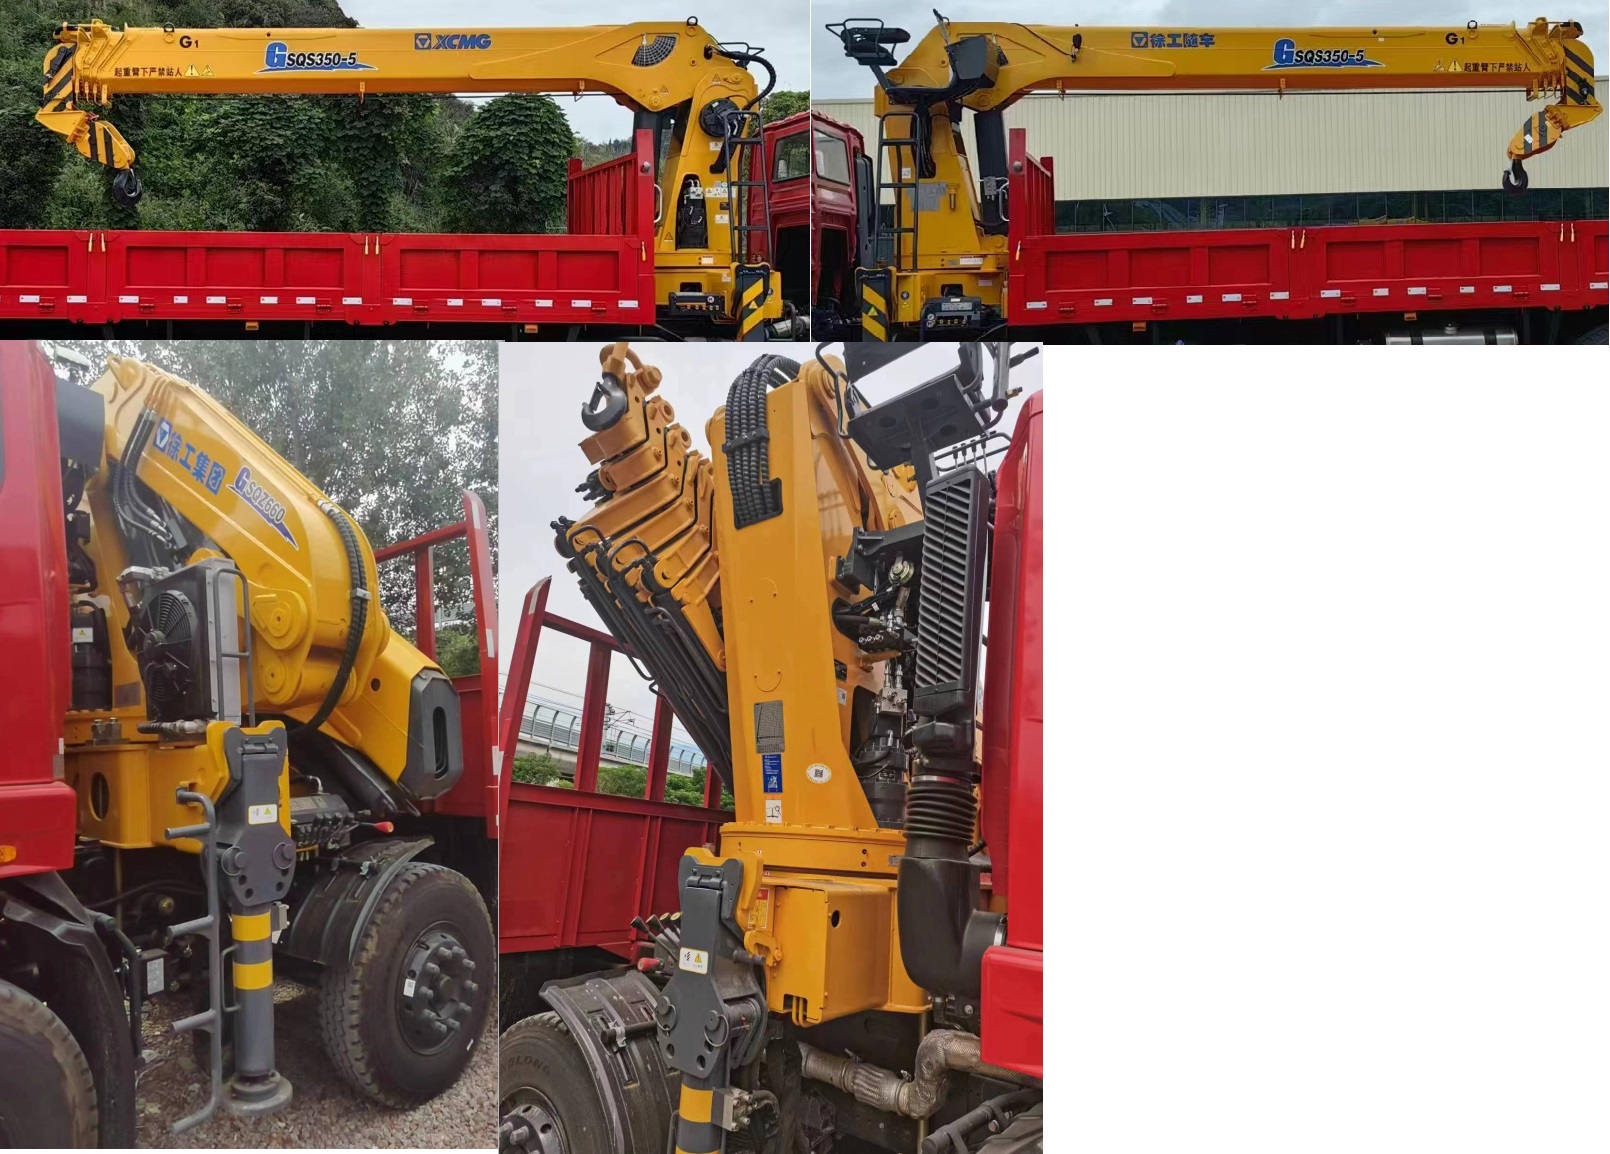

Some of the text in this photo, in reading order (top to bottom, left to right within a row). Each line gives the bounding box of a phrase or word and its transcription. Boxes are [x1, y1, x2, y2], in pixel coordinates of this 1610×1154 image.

[432, 33, 492, 50] XCMG
[1150, 33, 1216, 48] 徐工随车
[1273, 38, 1364, 65] GSQS350-5
[265, 41, 357, 69] GSQS350-5
[114, 67, 183, 77] 起重臂下严禁站人
[1464, 62, 1531, 72] 起重臂下严禁站人
[166, 431, 227, 496] 徐工集团
[233, 466, 287, 524] GSQZ660
